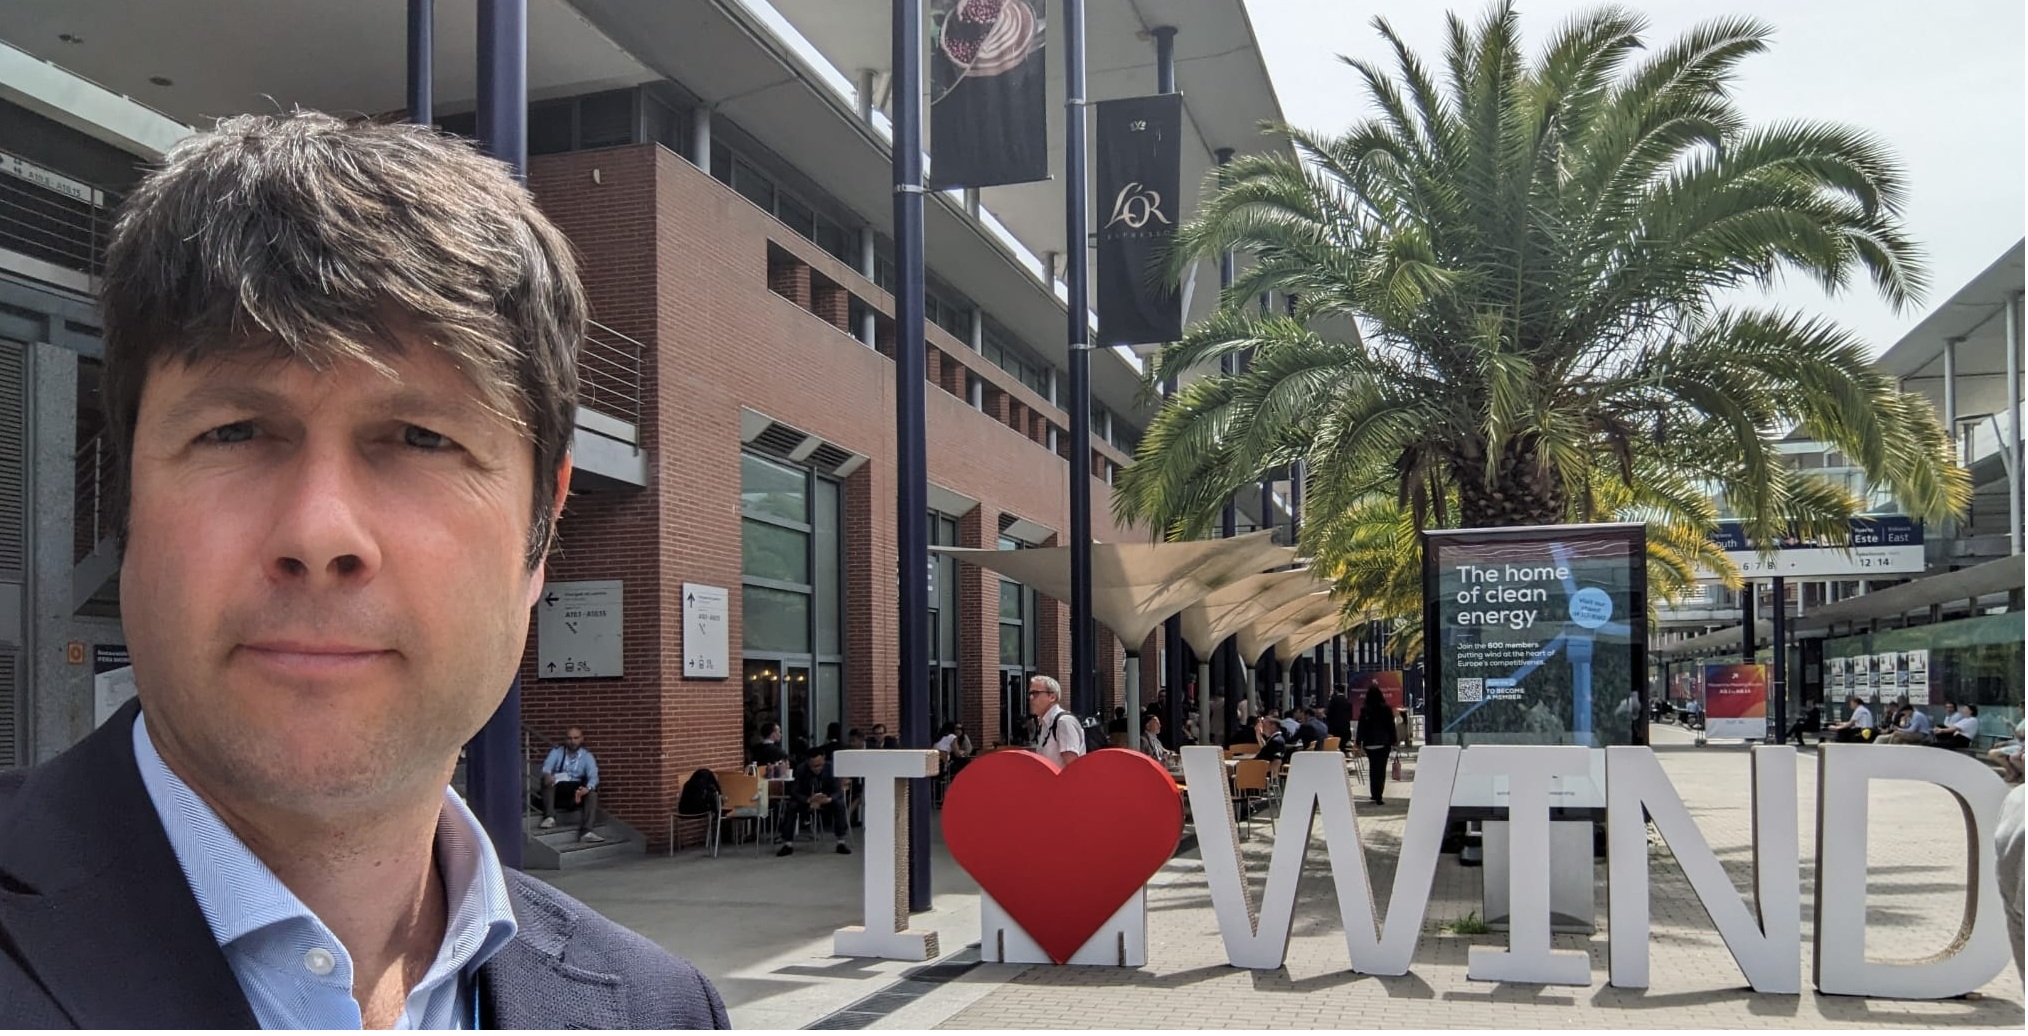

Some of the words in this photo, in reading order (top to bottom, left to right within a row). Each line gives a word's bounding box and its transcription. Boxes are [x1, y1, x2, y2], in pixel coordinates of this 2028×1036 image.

[1854, 534, 1879, 543] Este
[1888, 533, 1909, 542] East
[1860, 558, 1871, 567] 12
[1878, 557, 1890, 566] 14
[1743, 562, 1749, 571] 6
[1456, 565, 1499, 583] The
[1505, 564, 1569, 582] home
[1457, 586, 1480, 604] of
[1485, 585, 1547, 604] clean
[1457, 609, 1538, 630] energy
[1505, 641, 1539, 649] members
[1457, 651, 1483, 659] putting
[1457, 660, 1488, 668] Europe's
[833, 749, 940, 961] I
[1180, 743, 2013, 1000] WIND
